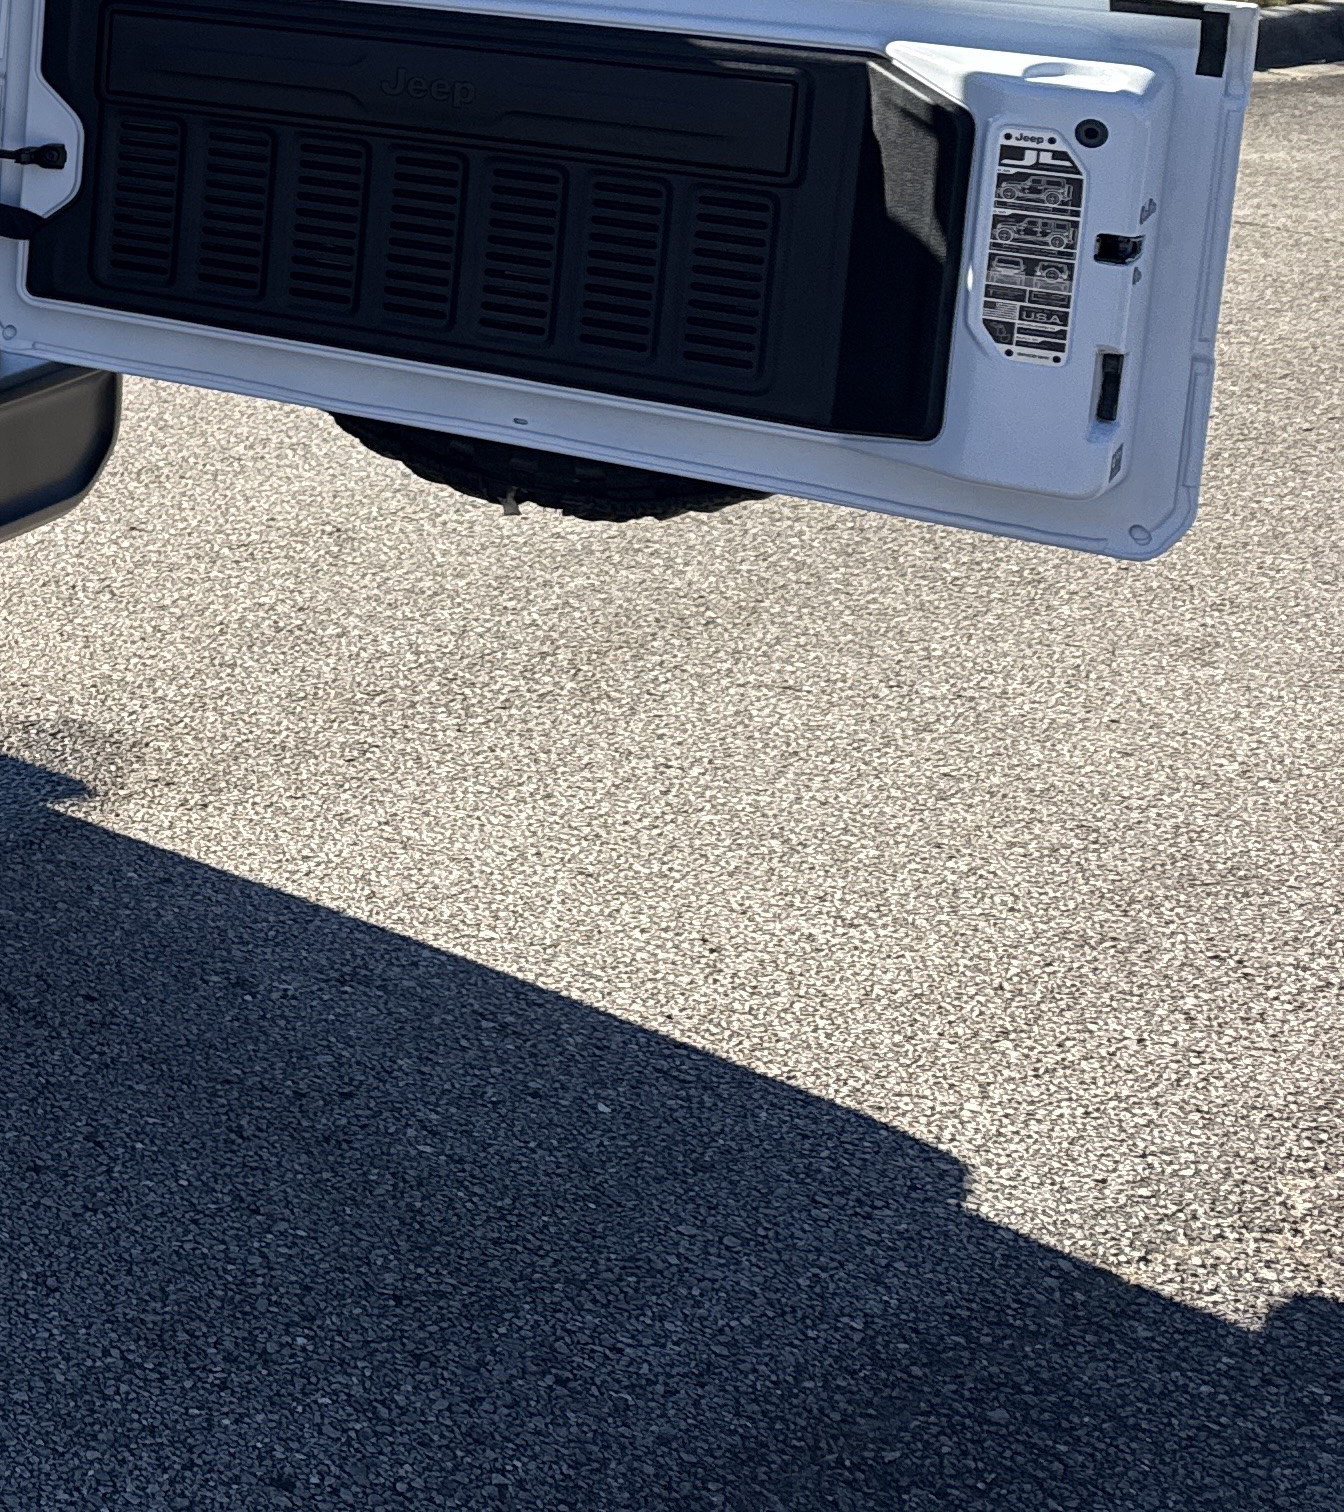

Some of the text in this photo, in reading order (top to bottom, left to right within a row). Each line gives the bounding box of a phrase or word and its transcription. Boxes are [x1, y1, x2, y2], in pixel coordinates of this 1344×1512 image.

[379, 66, 478, 109] Jeep
[1014, 132, 1045, 145] Jeep
[1000, 149, 1074, 167] JL
[1022, 310, 1064, 325] USA
